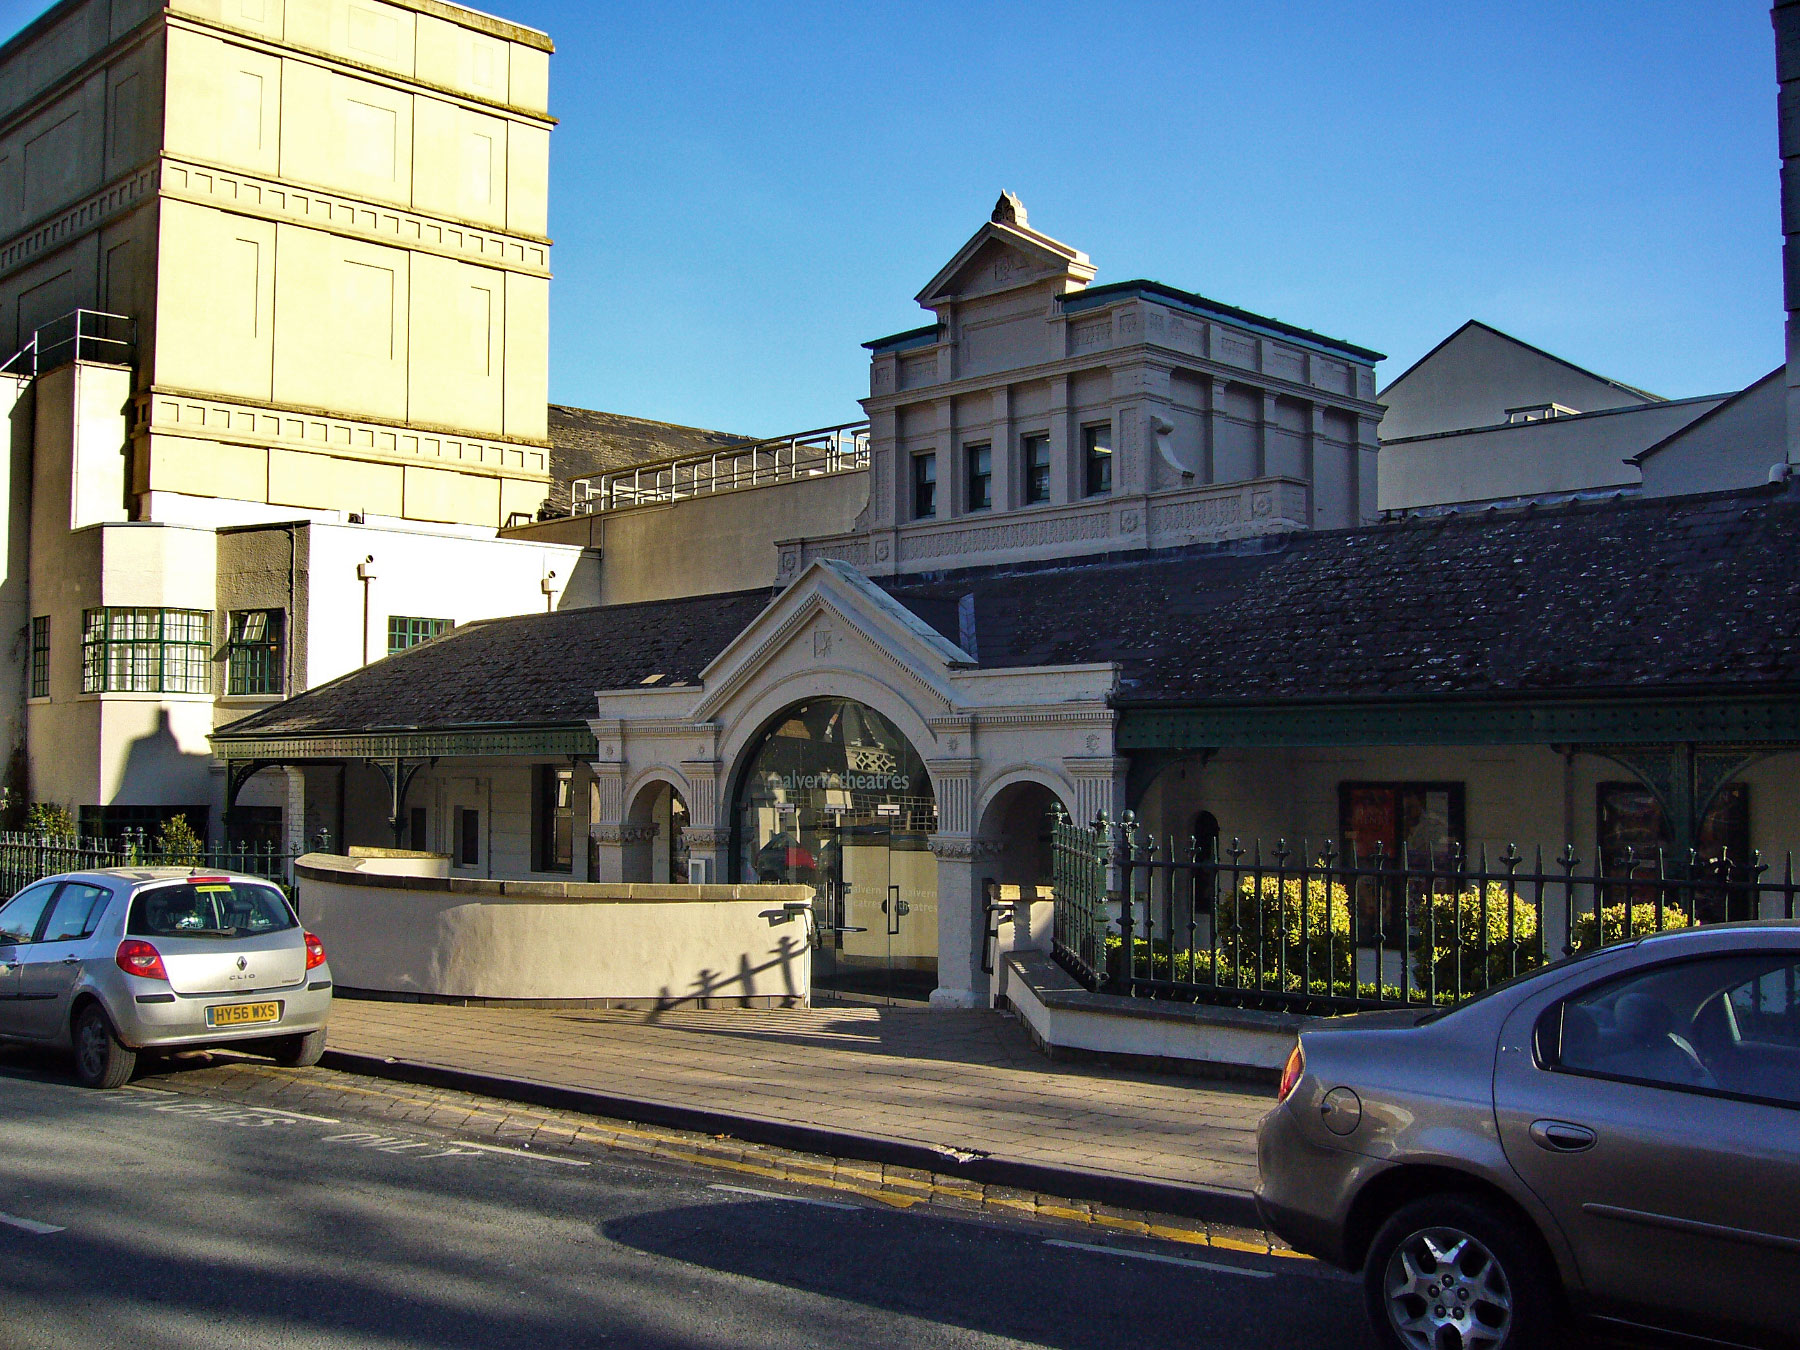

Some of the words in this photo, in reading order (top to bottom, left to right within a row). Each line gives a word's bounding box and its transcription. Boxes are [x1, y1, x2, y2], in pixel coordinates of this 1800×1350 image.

[767, 769, 831, 789] malvern
[839, 769, 910, 790] theatres
[229, 973, 256, 981] CLIO
[215, 1006, 249, 1021] HY56
[252, 1004, 275, 1019] WXS
[321, 1132, 485, 1159] ONLY
